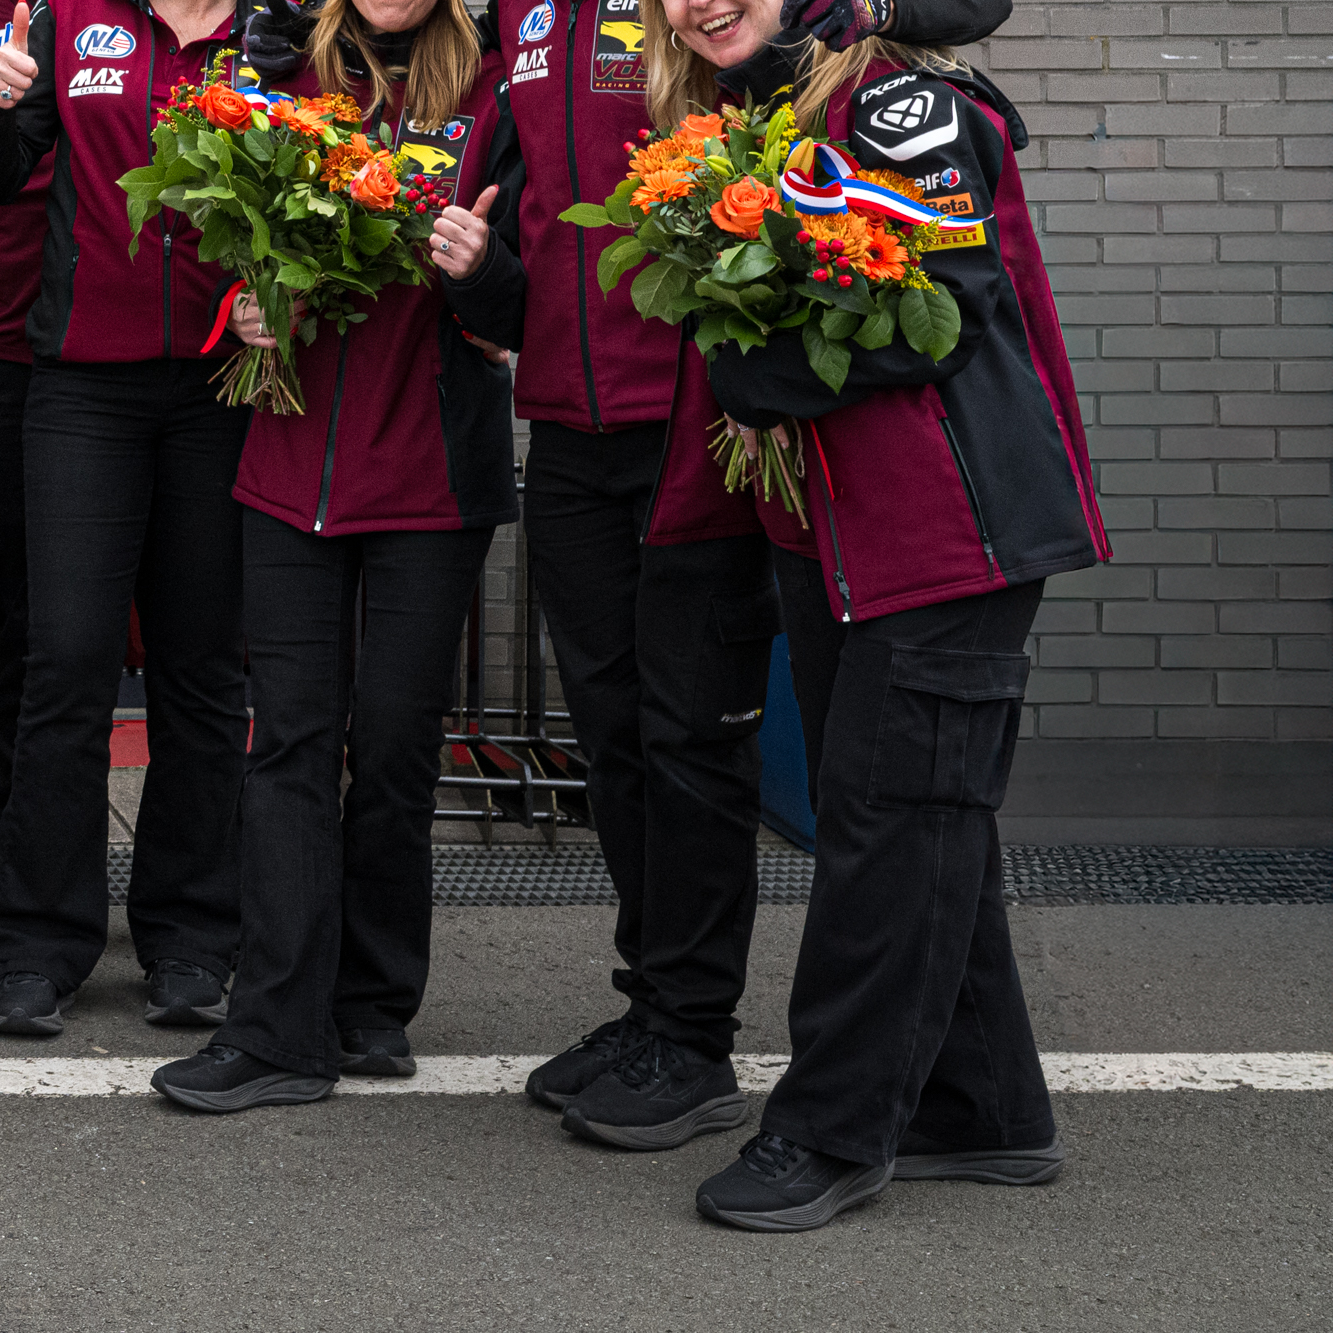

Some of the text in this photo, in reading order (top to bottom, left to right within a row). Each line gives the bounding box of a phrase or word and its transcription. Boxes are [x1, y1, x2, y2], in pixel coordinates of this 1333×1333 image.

[513, 47, 548, 74] MAX
[69, 67, 124, 88] MAX
[519, 71, 538, 81] CASES
[81, 86, 107, 94] CASES
[860, 74, 918, 105] IXON
